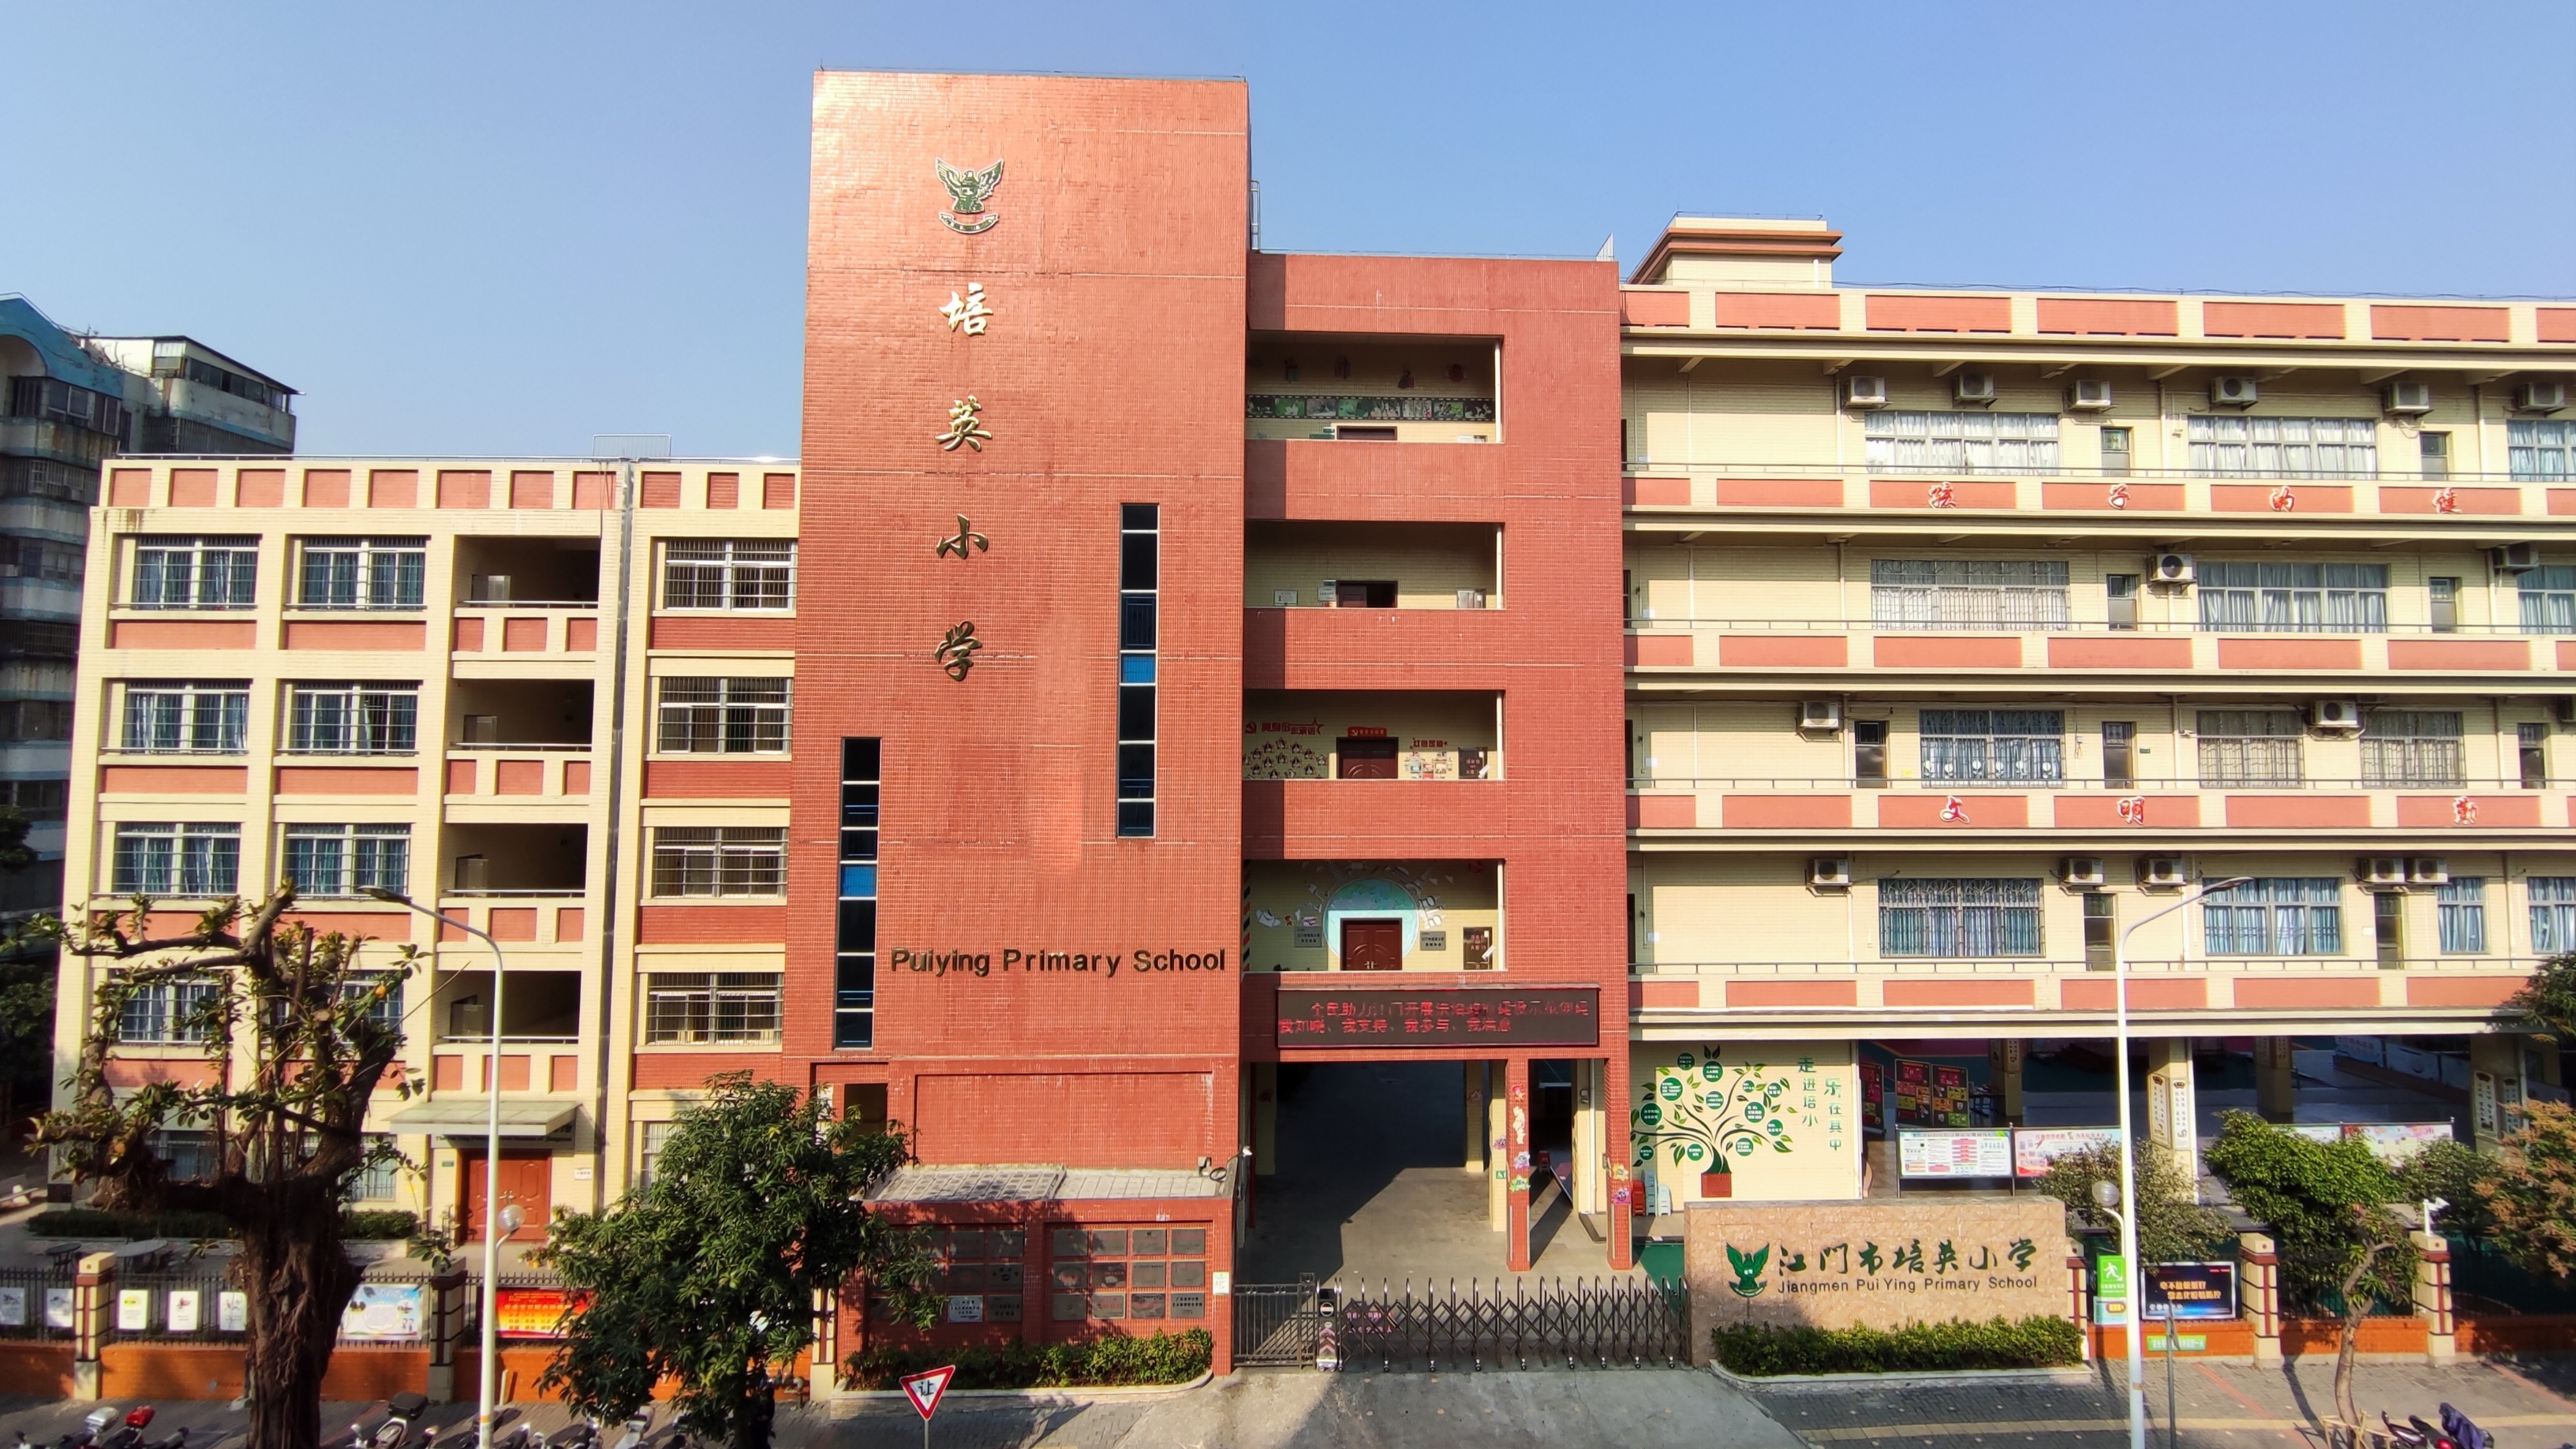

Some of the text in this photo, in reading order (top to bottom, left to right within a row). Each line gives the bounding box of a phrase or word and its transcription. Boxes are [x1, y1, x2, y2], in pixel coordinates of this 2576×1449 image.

[934, 282, 994, 682] 培英小学
[890, 947, 1225, 978] Puiying Primary School
[1798, 1056, 1819, 1127] 走进培小
[1778, 1238, 2037, 1277] 江门市培英小学
[1778, 1275, 2037, 1294] Jiangmen Pui Ying Primary School
[918, 1379, 935, 1398] 让
